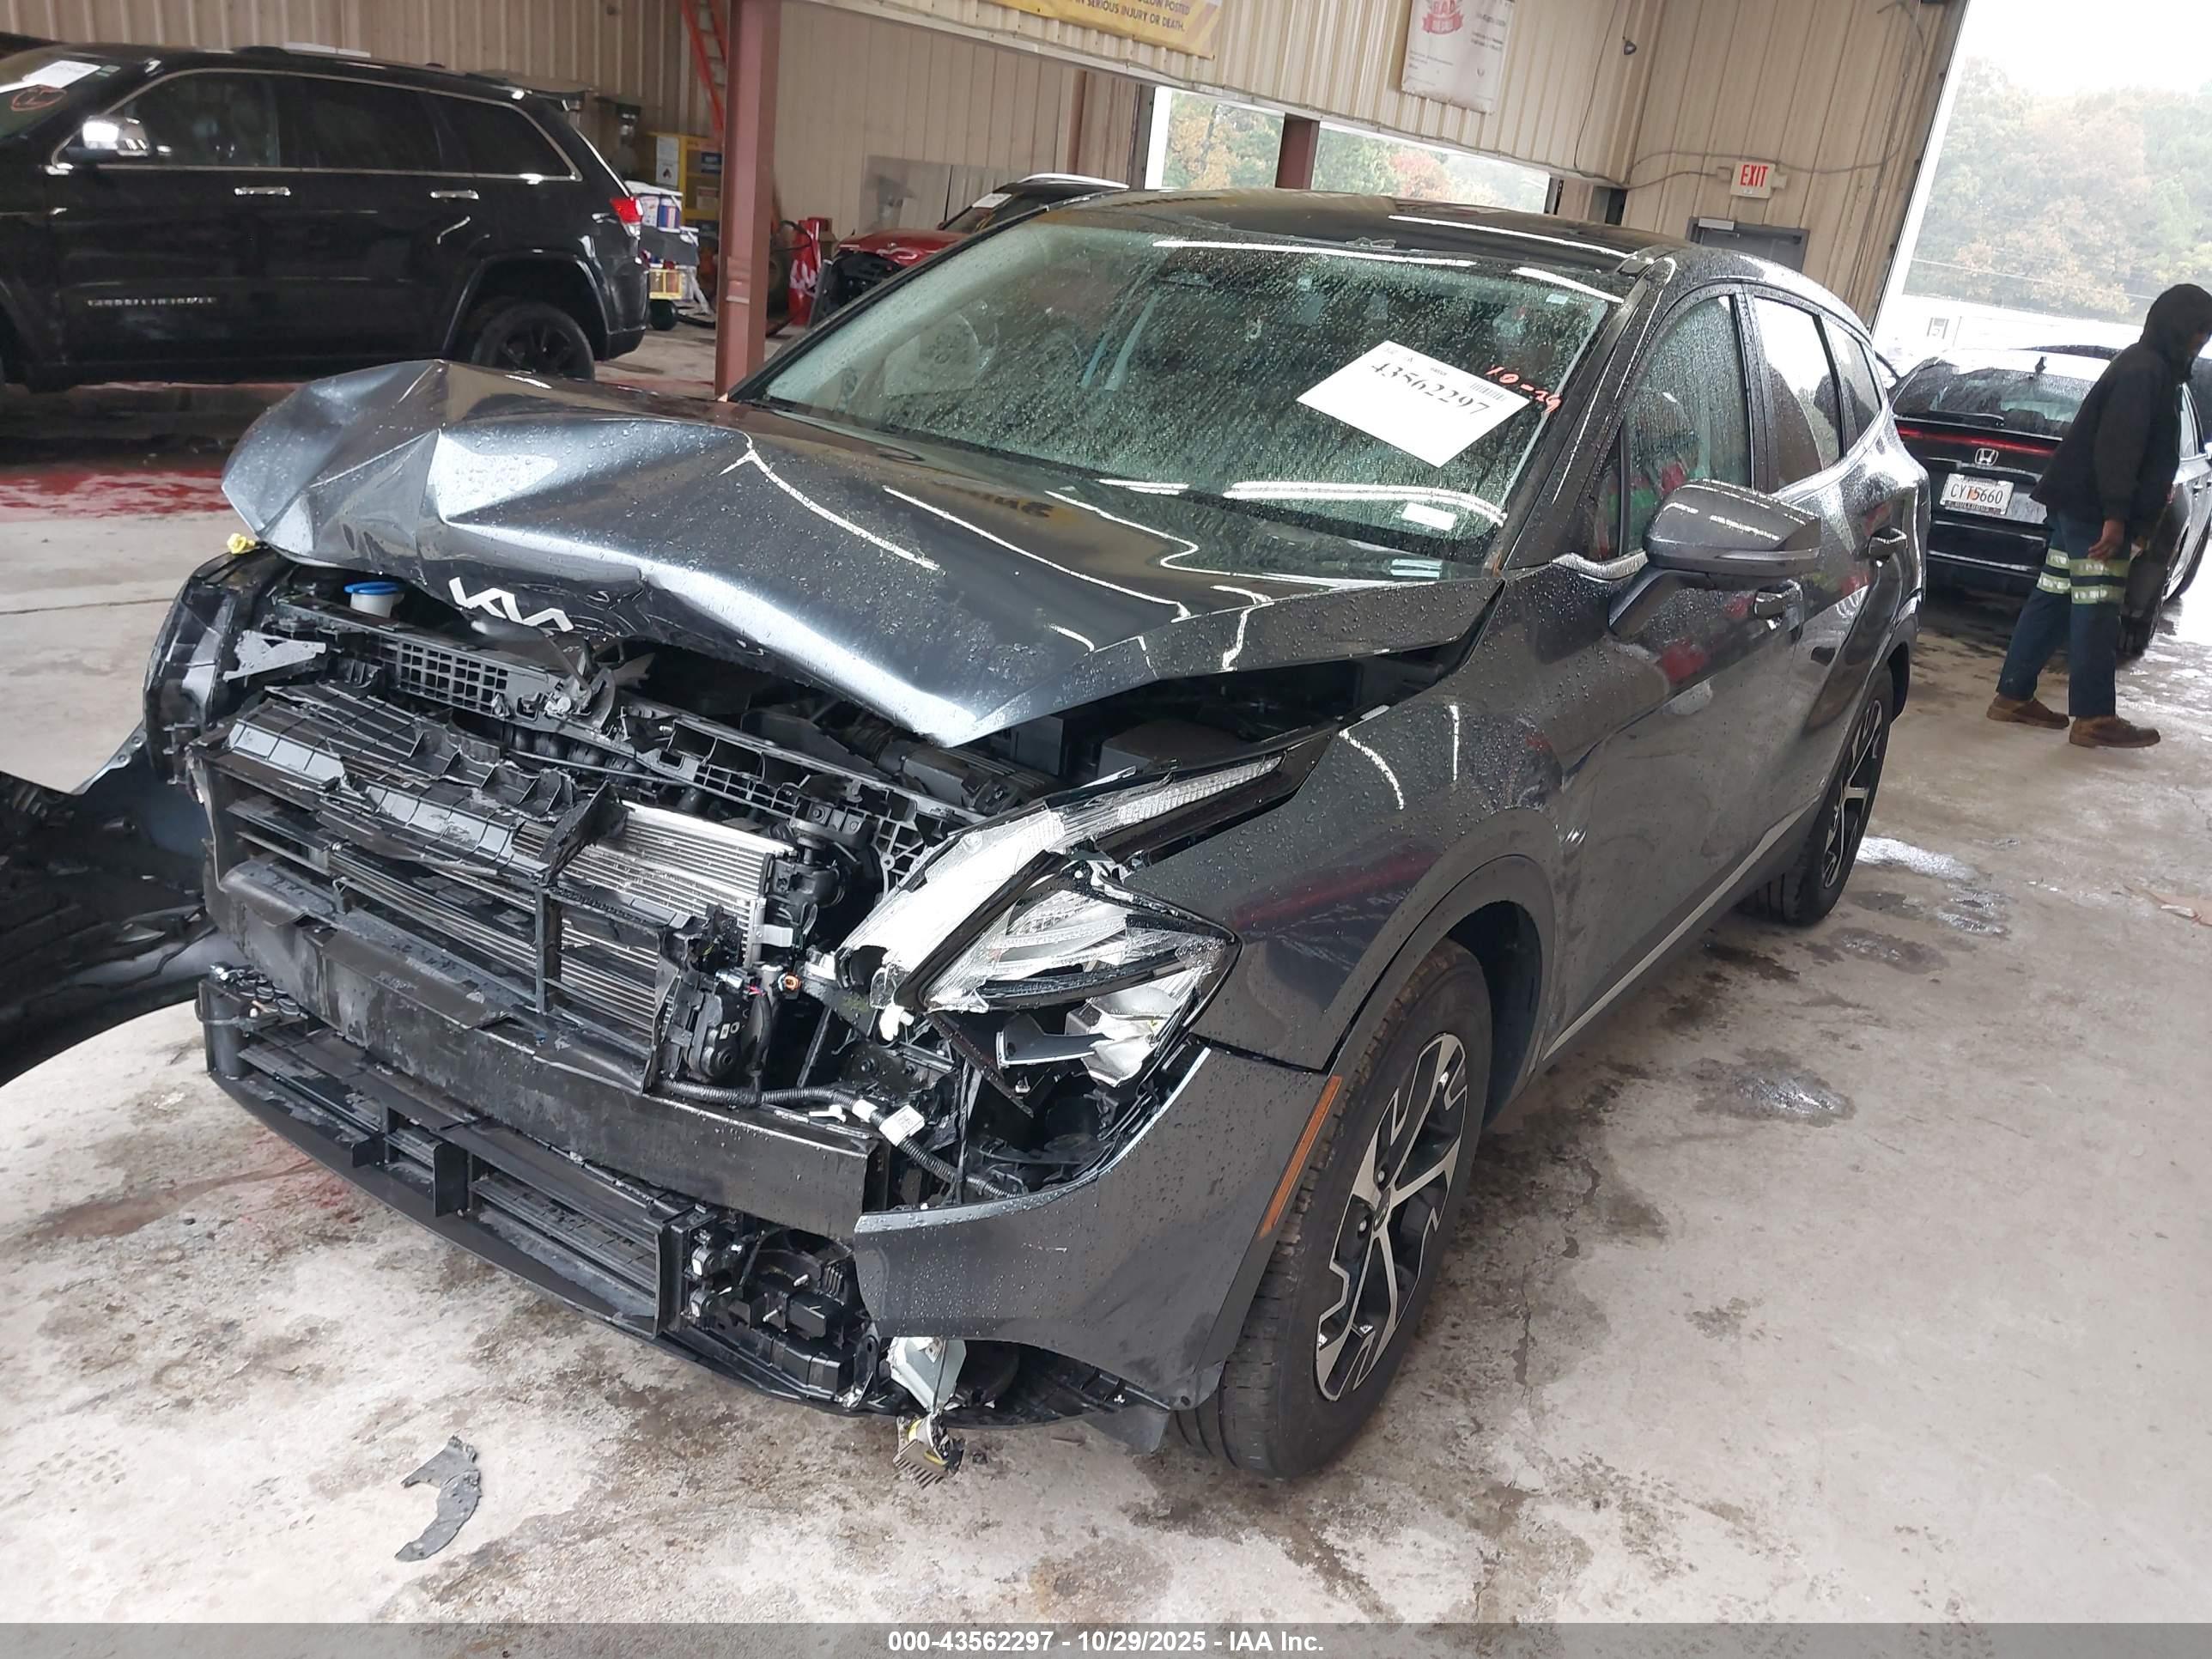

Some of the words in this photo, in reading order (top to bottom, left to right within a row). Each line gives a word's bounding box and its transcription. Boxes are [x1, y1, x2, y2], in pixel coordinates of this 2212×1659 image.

[1120, 5, 1148, 21] INJURY
[1150, 13, 1161, 25] OR
[1740, 164, 1768, 187] EXIT
[1370, 362, 1491, 414] 43562297
[1950, 483, 2003, 505] CYT5660
